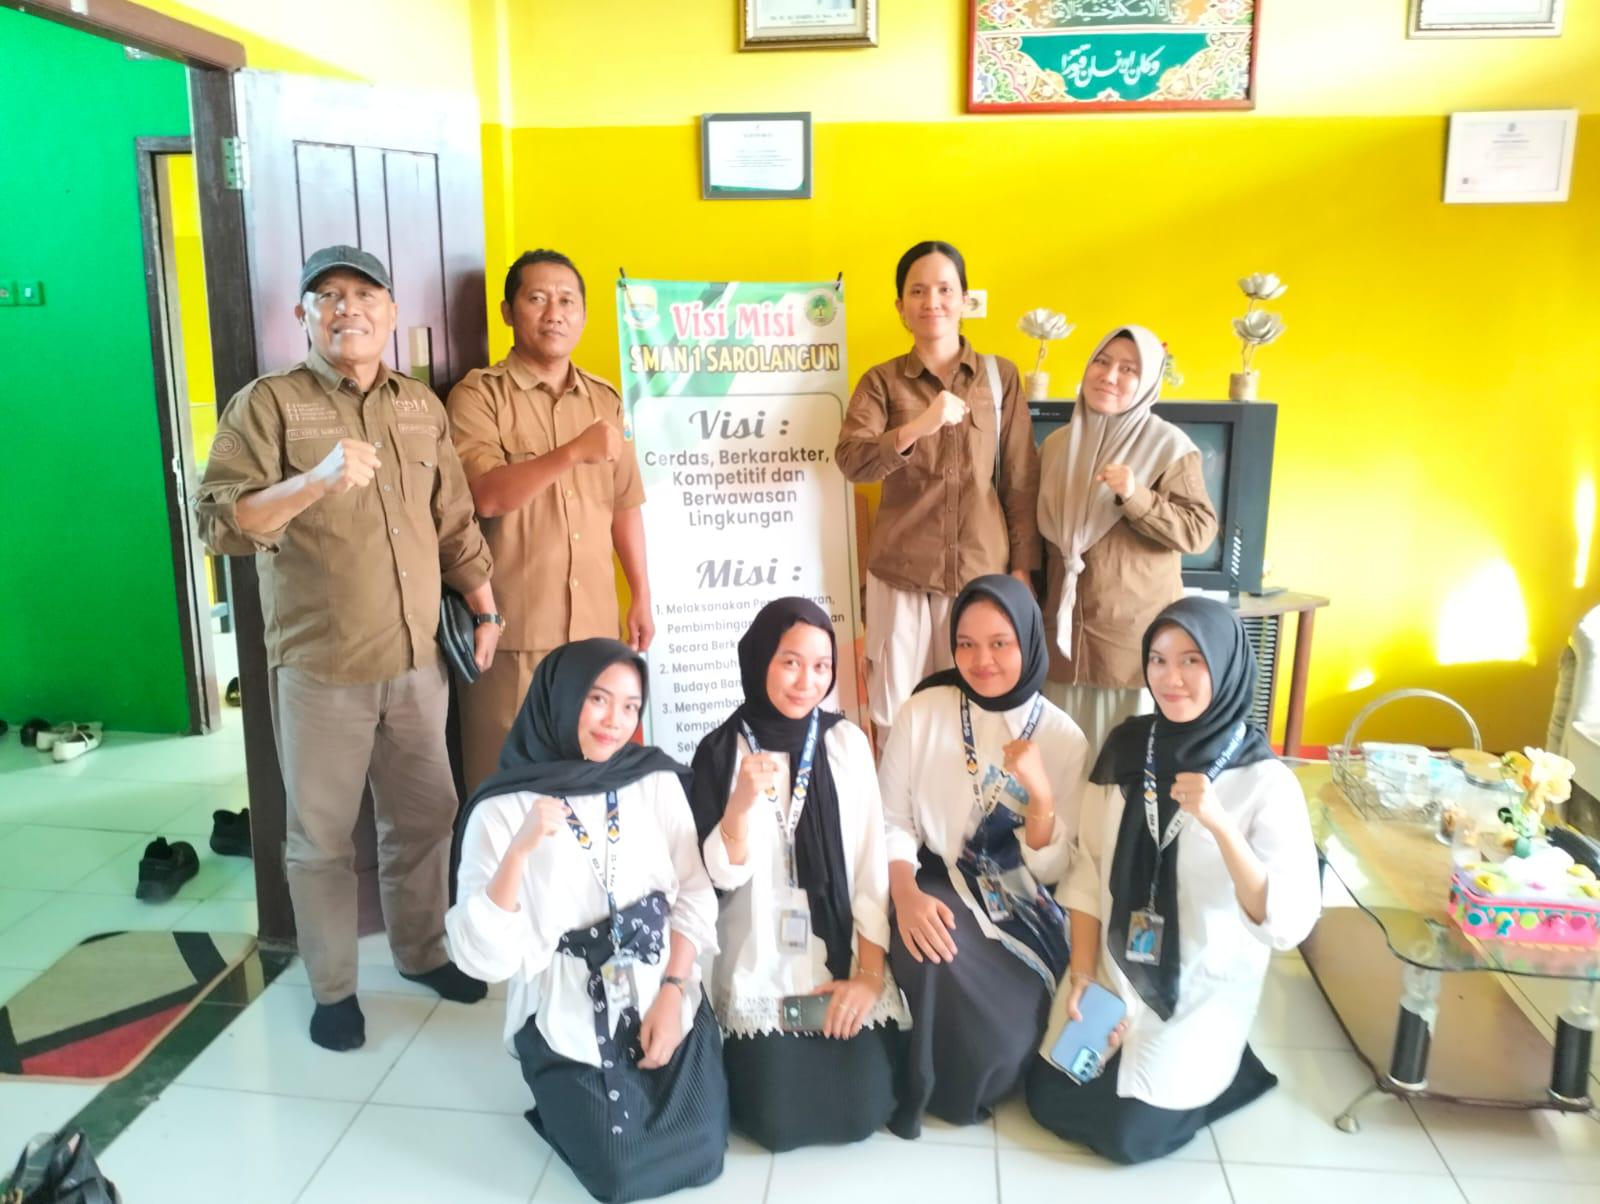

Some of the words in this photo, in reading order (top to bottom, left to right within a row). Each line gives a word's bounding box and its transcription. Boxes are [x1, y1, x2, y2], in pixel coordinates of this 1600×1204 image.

[671, 302, 726, 339] Visi
[736, 302, 797, 338] Misi
[630, 345, 689, 373] SMAN
[691, 344, 701, 373] 1
[705, 343, 840, 373] SAROLANGUN
[689, 410, 766, 440] Visi
[645, 450, 715, 468] Cerdas,
[719, 446, 830, 465] Berkarakter,
[673, 468, 767, 489] Kompetitif
[772, 467, 805, 483] dan
[683, 488, 797, 507] Berwawasan
[689, 508, 794, 530] Lingkungan
[696, 558, 778, 589] Misi
[656, 603, 664, 616] 1.
[666, 599, 751, 615] Melaksanakan
[668, 642, 709, 654] Secara
[660, 663, 669, 675] 2.
[671, 658, 738, 673] Menumbuh
[673, 681, 718, 694] Budaya
[662, 702, 673, 715] 3.
